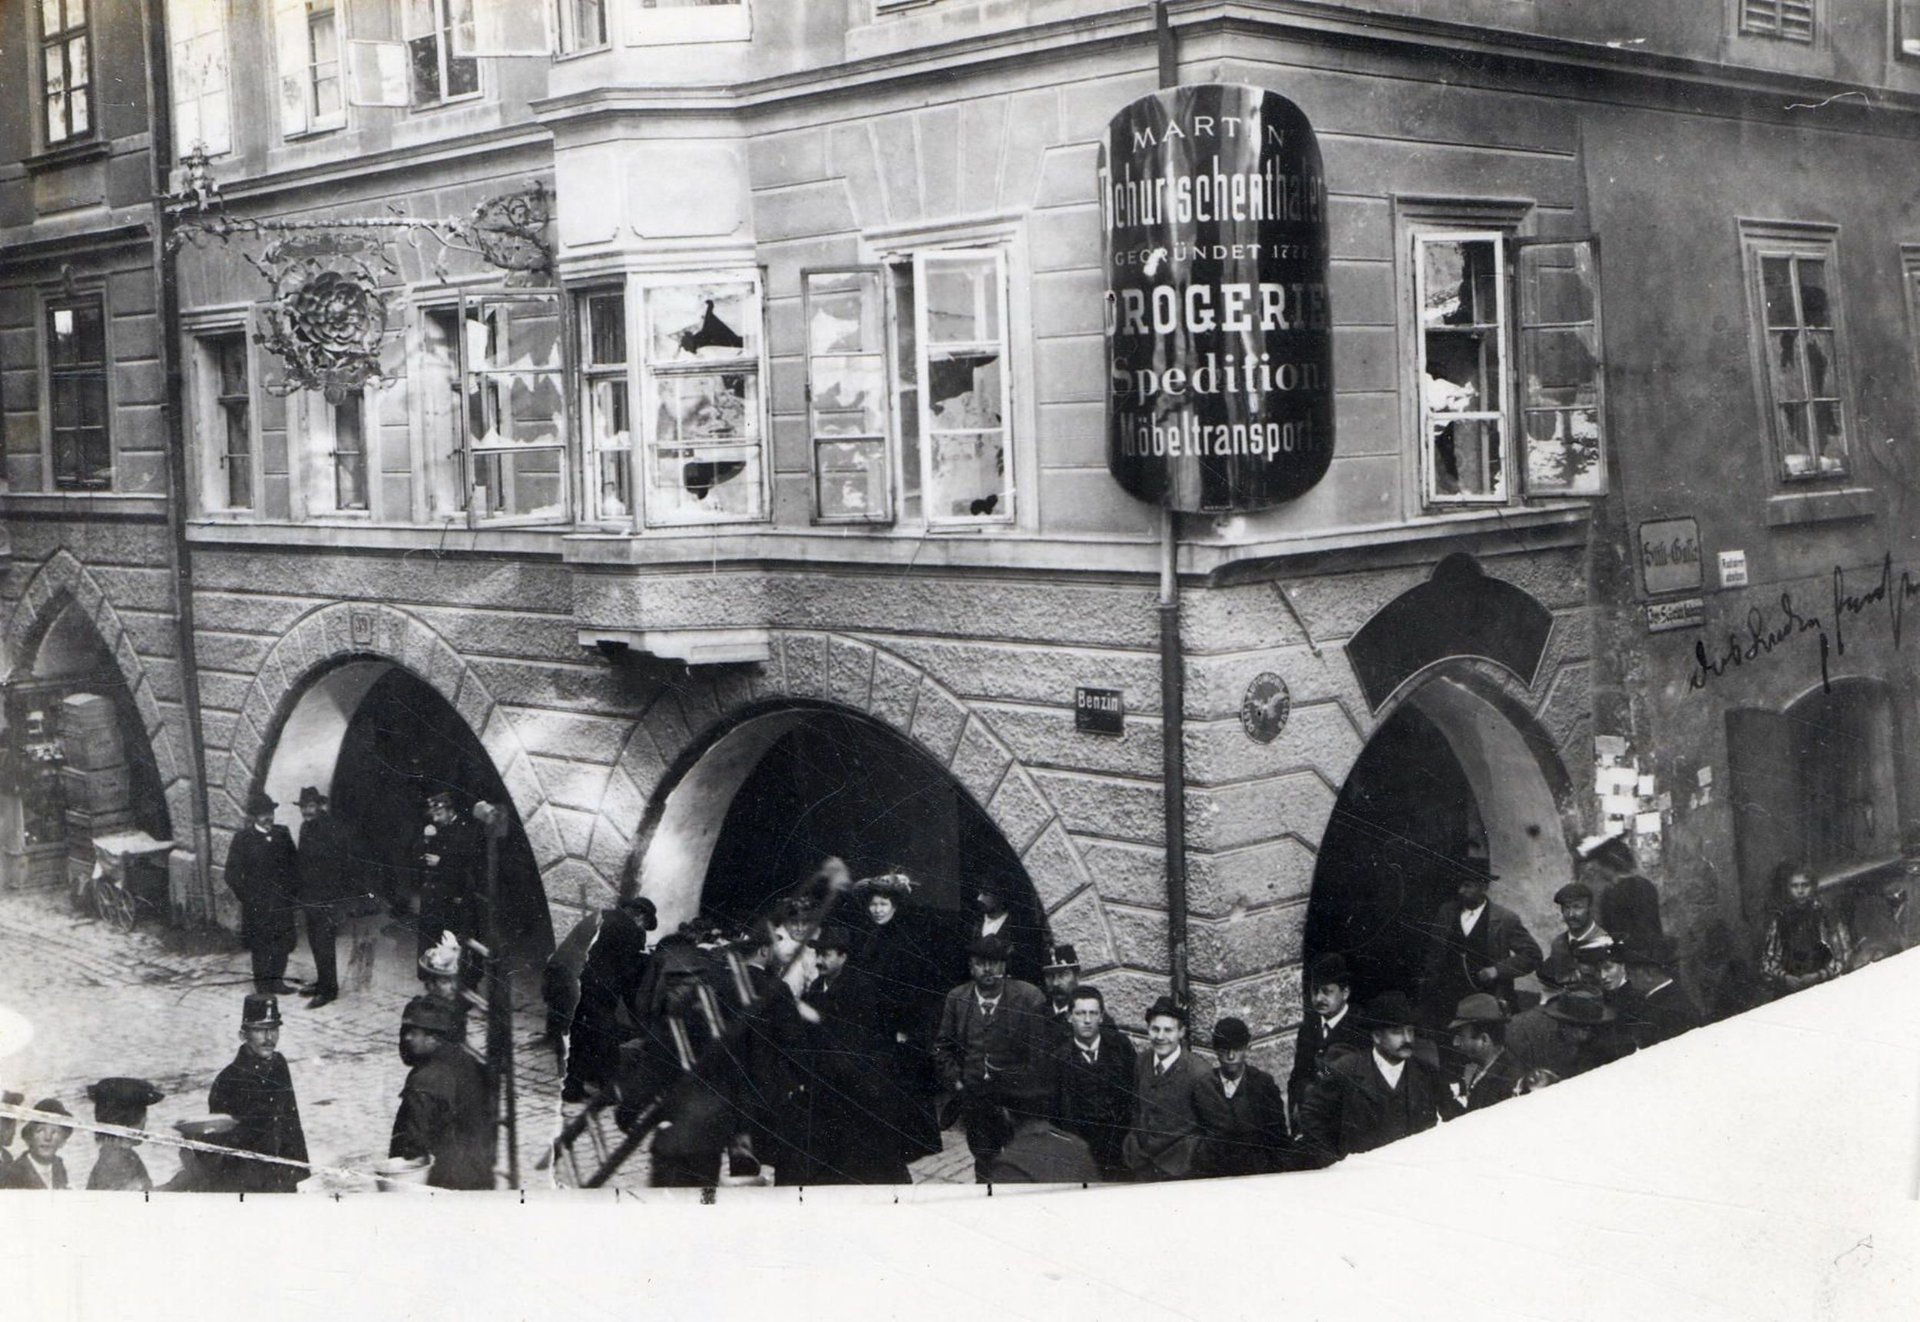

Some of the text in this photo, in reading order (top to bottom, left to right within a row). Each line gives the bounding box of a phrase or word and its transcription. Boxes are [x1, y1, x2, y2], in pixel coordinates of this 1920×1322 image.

[1132, 116, 1285, 153] MARTN
[1099, 154, 1324, 232] Tchurtschenthaler
[1103, 282, 1326, 336] DROGERIE
[1078, 690, 1118, 711] Benzin
